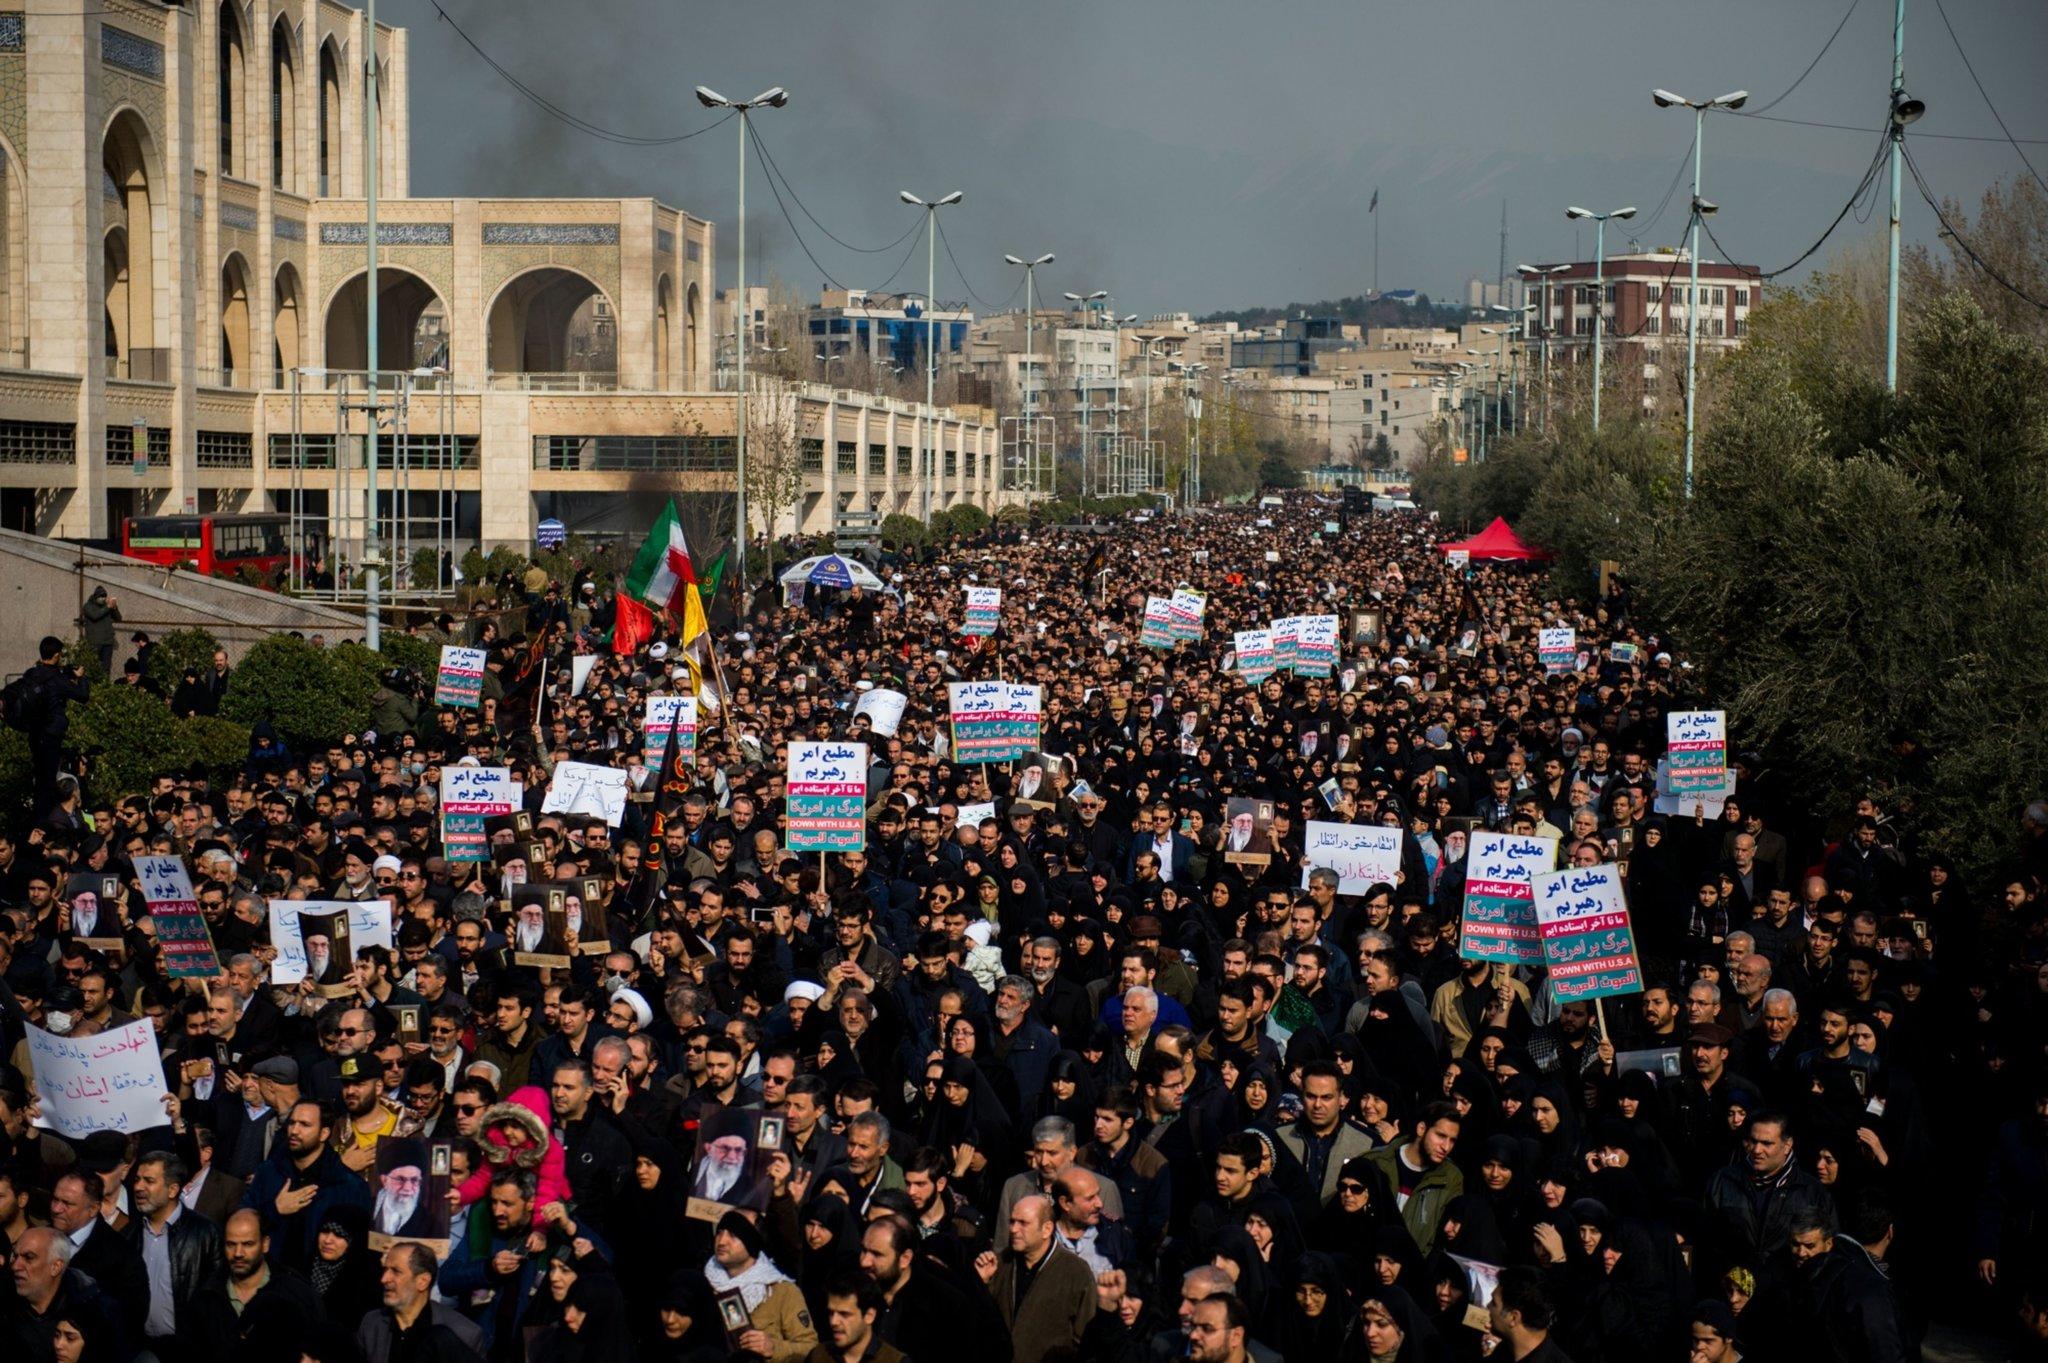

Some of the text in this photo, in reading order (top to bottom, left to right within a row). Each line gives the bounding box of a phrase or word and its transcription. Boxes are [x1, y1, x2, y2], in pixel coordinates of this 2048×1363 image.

[1677, 714, 1716, 727] مطیع امر
[799, 745, 855, 762] مطیع امر
[452, 770, 502, 785] مطیع امر
[805, 766, 846, 780] رهبریم
[458, 789, 494, 801] رهبریم
[823, 804, 835, 817] بر
[837, 799, 861, 817] مرگ
[790, 820, 861, 828] DOWN WITH U.S.A
[1481, 838, 1544, 859] مطیع امر
[1487, 862, 1531, 881] رهبریم
[1546, 871, 1608, 898] مطیع امر
[1520, 904, 1537, 925] رگ
[1556, 896, 1603, 917] رهبریم
[1590, 916, 1605, 932] آخر
[1607, 916, 1614, 925] تا
[1615, 915, 1624, 924] ما
[1466, 924, 1495, 935] DOWN
[1497, 927, 1520, 937] WITH
[1588, 942, 1600, 957] بر
[1602, 932, 1629, 953] مرگ
[1551, 957, 1633, 977] DOWN WITH U.S.A
[1600, 969, 1637, 989] الموت
[93, 1026, 148, 1058] شهادت
[66, 1076, 109, 1104] ایشان
